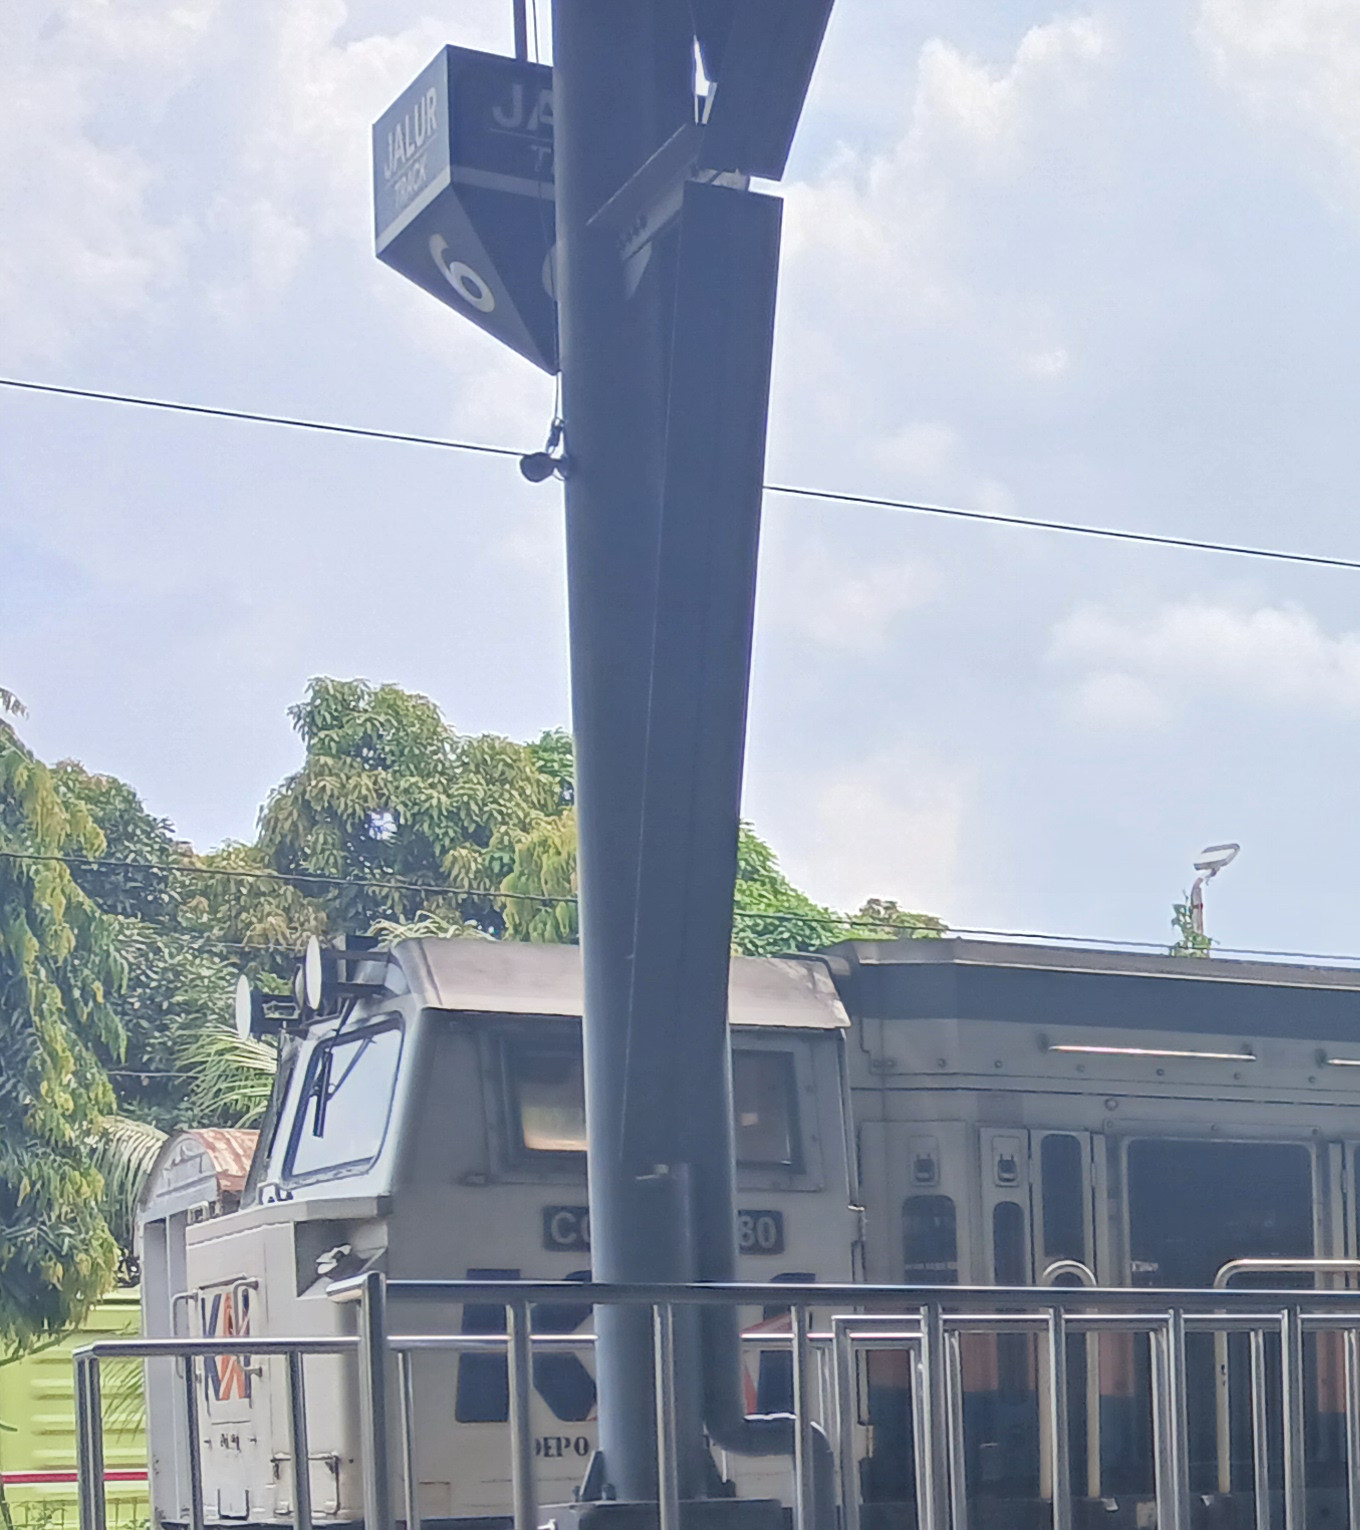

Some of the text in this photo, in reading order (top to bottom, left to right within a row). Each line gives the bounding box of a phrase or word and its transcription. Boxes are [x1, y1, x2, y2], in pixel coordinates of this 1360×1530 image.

[383, 86, 438, 179] JALUR
[428, 232, 496, 314] 6
[550, 1211, 591, 1245] C
